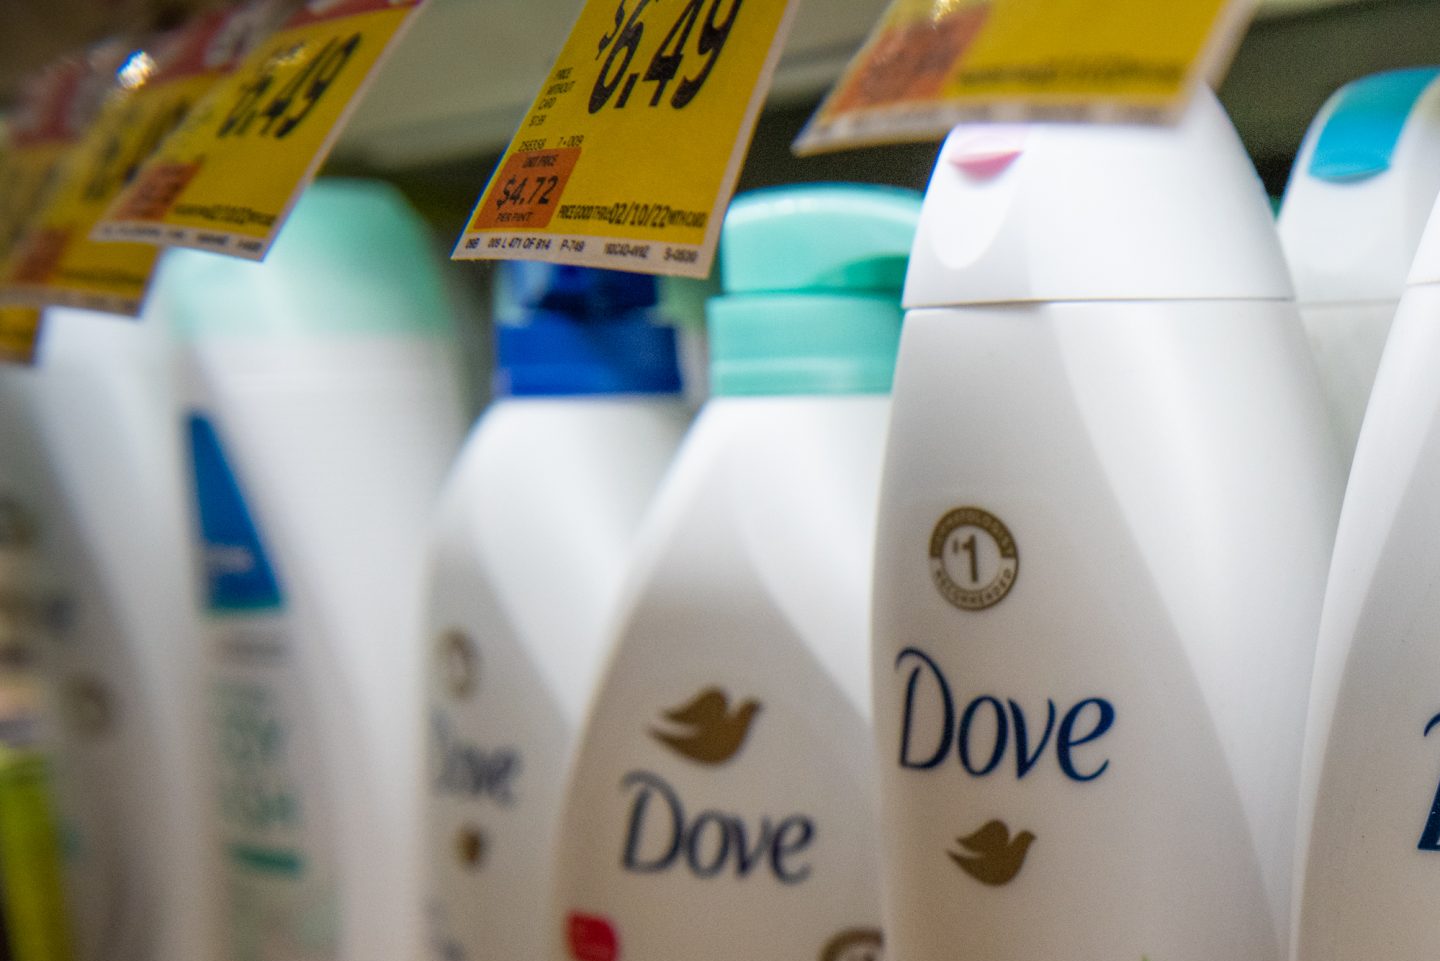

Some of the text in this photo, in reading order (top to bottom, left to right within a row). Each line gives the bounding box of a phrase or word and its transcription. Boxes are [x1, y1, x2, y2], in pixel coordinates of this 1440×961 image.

[496, 175, 559, 210] $4.72
[608, 202, 671, 228] 02/10/22
[896, 647, 1115, 782] Dove
[621, 770, 814, 884] Dove
